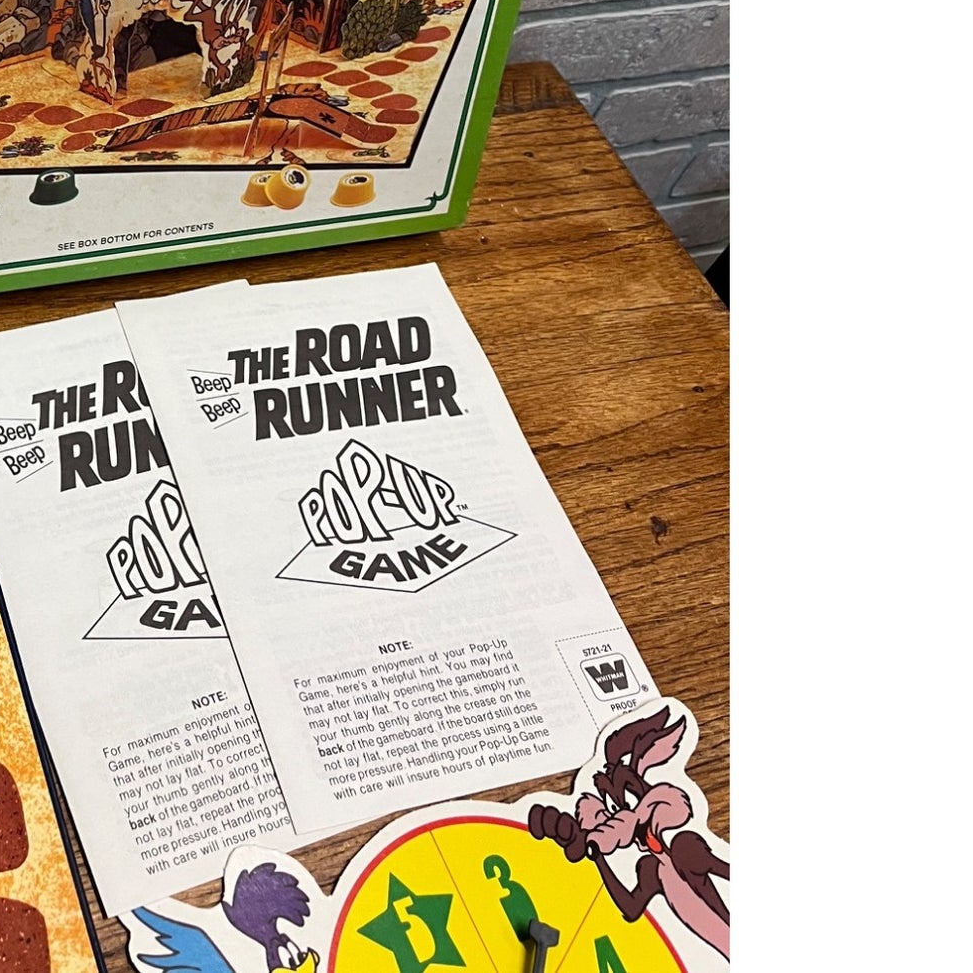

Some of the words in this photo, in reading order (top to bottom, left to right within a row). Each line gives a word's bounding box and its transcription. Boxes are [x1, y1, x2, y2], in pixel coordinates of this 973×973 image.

[57, 242, 75, 251] SEE
[78, 238, 98, 248] BOX
[100, 232, 141, 245] BOTTOM
[143, 230, 162, 239] FOR
[164, 222, 214, 236] CONTENTS
[227, 346, 290, 385] THE
[294, 315, 432, 377] ROAD
[31, 382, 97, 431] THE
[190, 374, 232, 395] Beep
[200, 395, 242, 424] Beep
[253, 364, 464, 441] RUNNER
[2, 442, 46, 476] Beep
[58, 418, 170, 492] RUN
[298, 438, 460, 547] POP-UP
[106, 479, 208, 600] POP
[328, 533, 469, 583] GAME
[139, 598, 223, 631] GA
[293, 678, 311, 689] For
[316, 667, 367, 684] maximum
[371, 654, 425, 674] enjoyment
[428, 651, 439, 662] of
[442, 647, 465, 661] your
[468, 638, 508, 653] Pop-Up
[378, 639, 414, 655] NOTE:
[582, 643, 613, 657] 5721-21
[191, 690, 228, 710] NOTE:
[298, 689, 333, 702] Game,
[335, 680, 368, 694] here's
[371, 679, 378, 688] a
[380, 669, 417, 685] helpful
[418, 665, 443, 677] hint.
[444, 661, 467, 671] You
[469, 656, 490, 667] may
[492, 649, 514, 662] find
[302, 703, 325, 716] that
[326, 699, 350, 711] after
[352, 690, 390, 706] initially
[393, 681, 435, 698] opening
[435, 677, 453, 688] the
[454, 664, 511, 687] gameboard
[511, 663, 520, 672] it
[595, 671, 625, 684] WHITMAN
[308, 718, 330, 729] may
[333, 712, 352, 724] not
[352, 709, 369, 720] lay
[371, 704, 390, 716] flat.
[392, 700, 409, 711] To
[410, 691, 448, 708] correct
[449, 688, 473, 699] this,
[473, 680, 505, 694] simply
[507, 676, 526, 687] run
[312, 731, 337, 746] your
[340, 721, 375, 737] thumb
[377, 714, 410, 732] gently
[413, 708, 443, 722] along
[443, 704, 462, 715] the
[463, 696, 497, 711] crease
[499, 693, 513, 703] on
[514, 689, 531, 699] the
[610, 699, 637, 712] PROOF
[317, 743, 345, 757] back
[345, 739, 357, 752] of
[357, 738, 375, 749] the
[375, 723, 436, 748] gameboard.
[436, 719, 446, 731] If
[445, 718, 463, 729] the
[462, 710, 494, 725] board
[494, 705, 513, 719] still
[513, 702, 538, 715] does
[323, 759, 342, 772] not
[343, 756, 359, 768] lay
[362, 750, 384, 763] flat,
[386, 741, 420, 758] repeat
[420, 739, 439, 750] the
[441, 729, 482, 747] process
[482, 722, 512, 736] using
[512, 720, 520, 729] a
[520, 714, 544, 727] little
[328, 772, 356, 786] more
[357, 762, 406, 782] pressure.
[405, 750, 455, 768] Handling
[454, 744, 478, 759] your
[478, 734, 519, 751] Pop-Up
[518, 728, 550, 742] Game
[333, 786, 357, 800] with
[359, 781, 383, 795] care
[385, 774, 405, 788] will
[406, 768, 440, 783] insure
[440, 760, 473, 775] hours
[474, 755, 486, 767] of
[488, 747, 532, 766] playtime
[532, 742, 555, 753] fun.
[392, 895, 437, 963] 5
